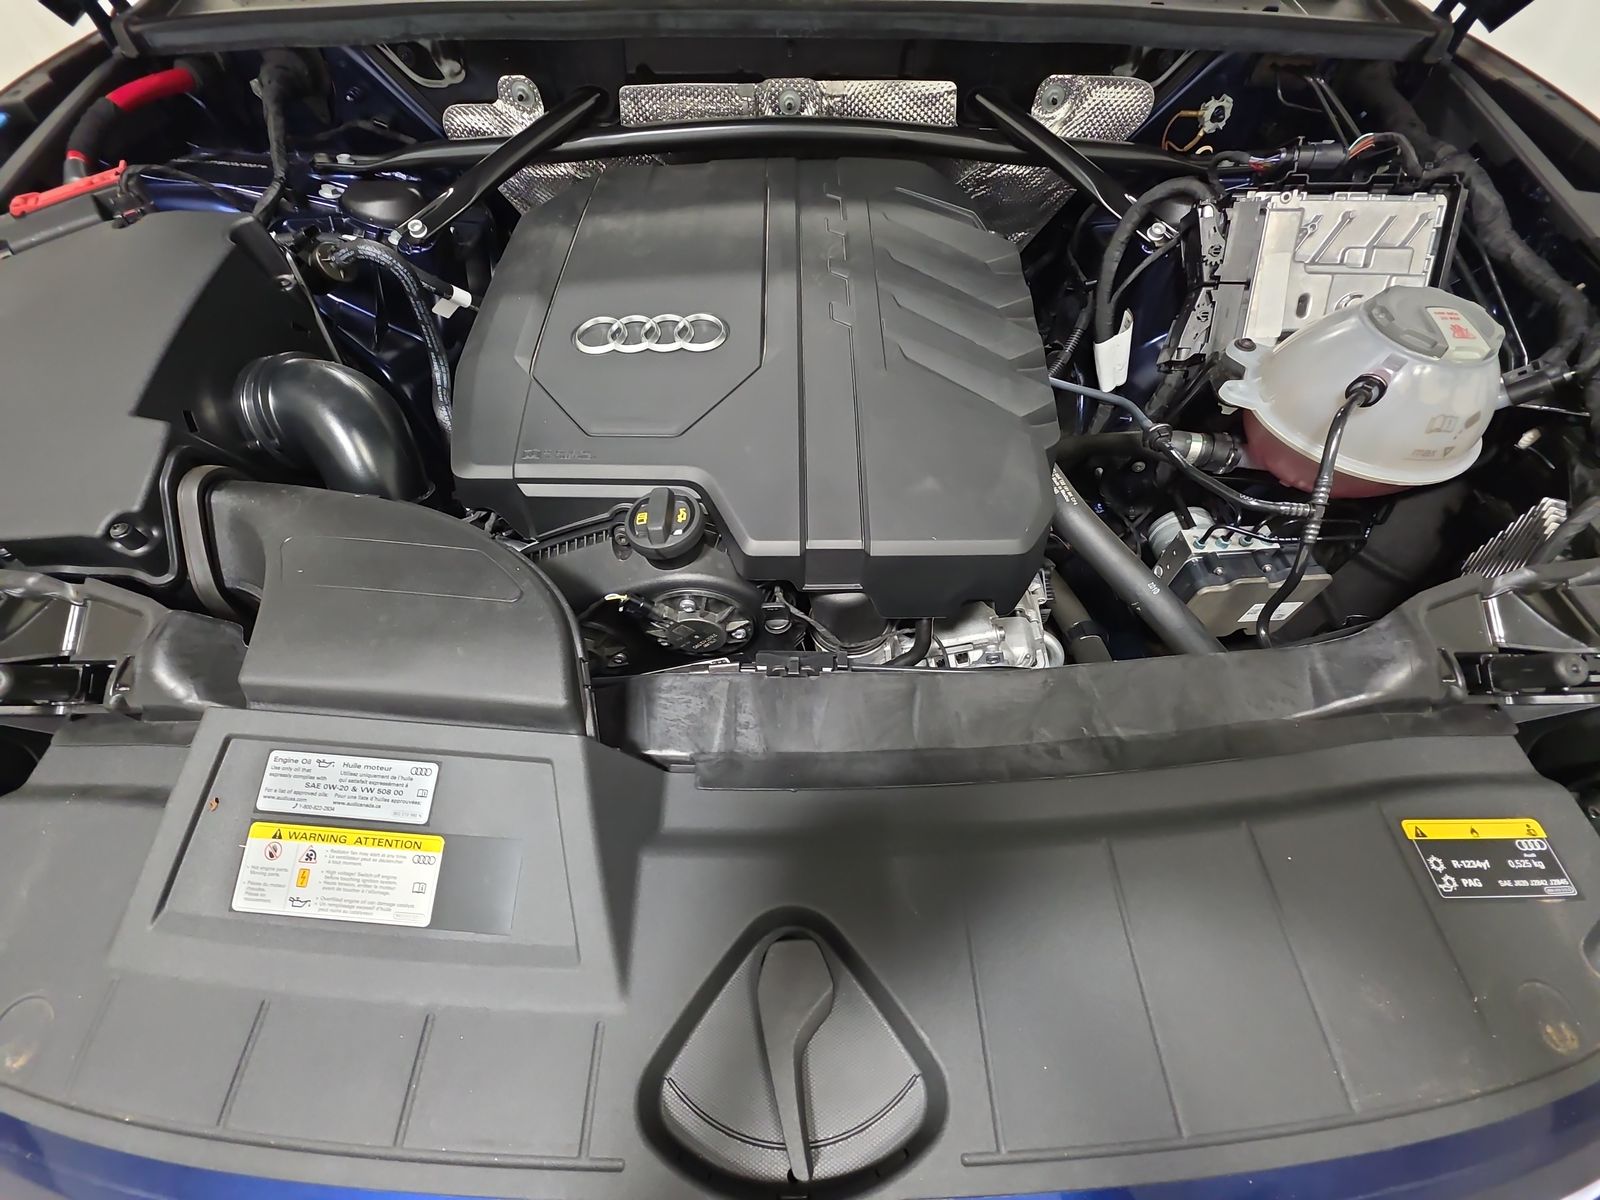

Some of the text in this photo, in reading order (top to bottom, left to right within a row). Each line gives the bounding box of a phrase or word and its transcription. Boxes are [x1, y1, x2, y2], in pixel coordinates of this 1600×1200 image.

[273, 756, 299, 764] Engine
[342, 762, 392, 772] Huile moteur
[293, 789, 318, 797] approved
[304, 782, 322, 790] SAE
[323, 783, 350, 792] 0W-20
[360, 786, 376, 794] VW
[288, 831, 423, 850] WARNING ATTENTION
[1451, 859, 1546, 870] R-1234yf 0,525 kg
[1461, 878, 1483, 888] PAG
